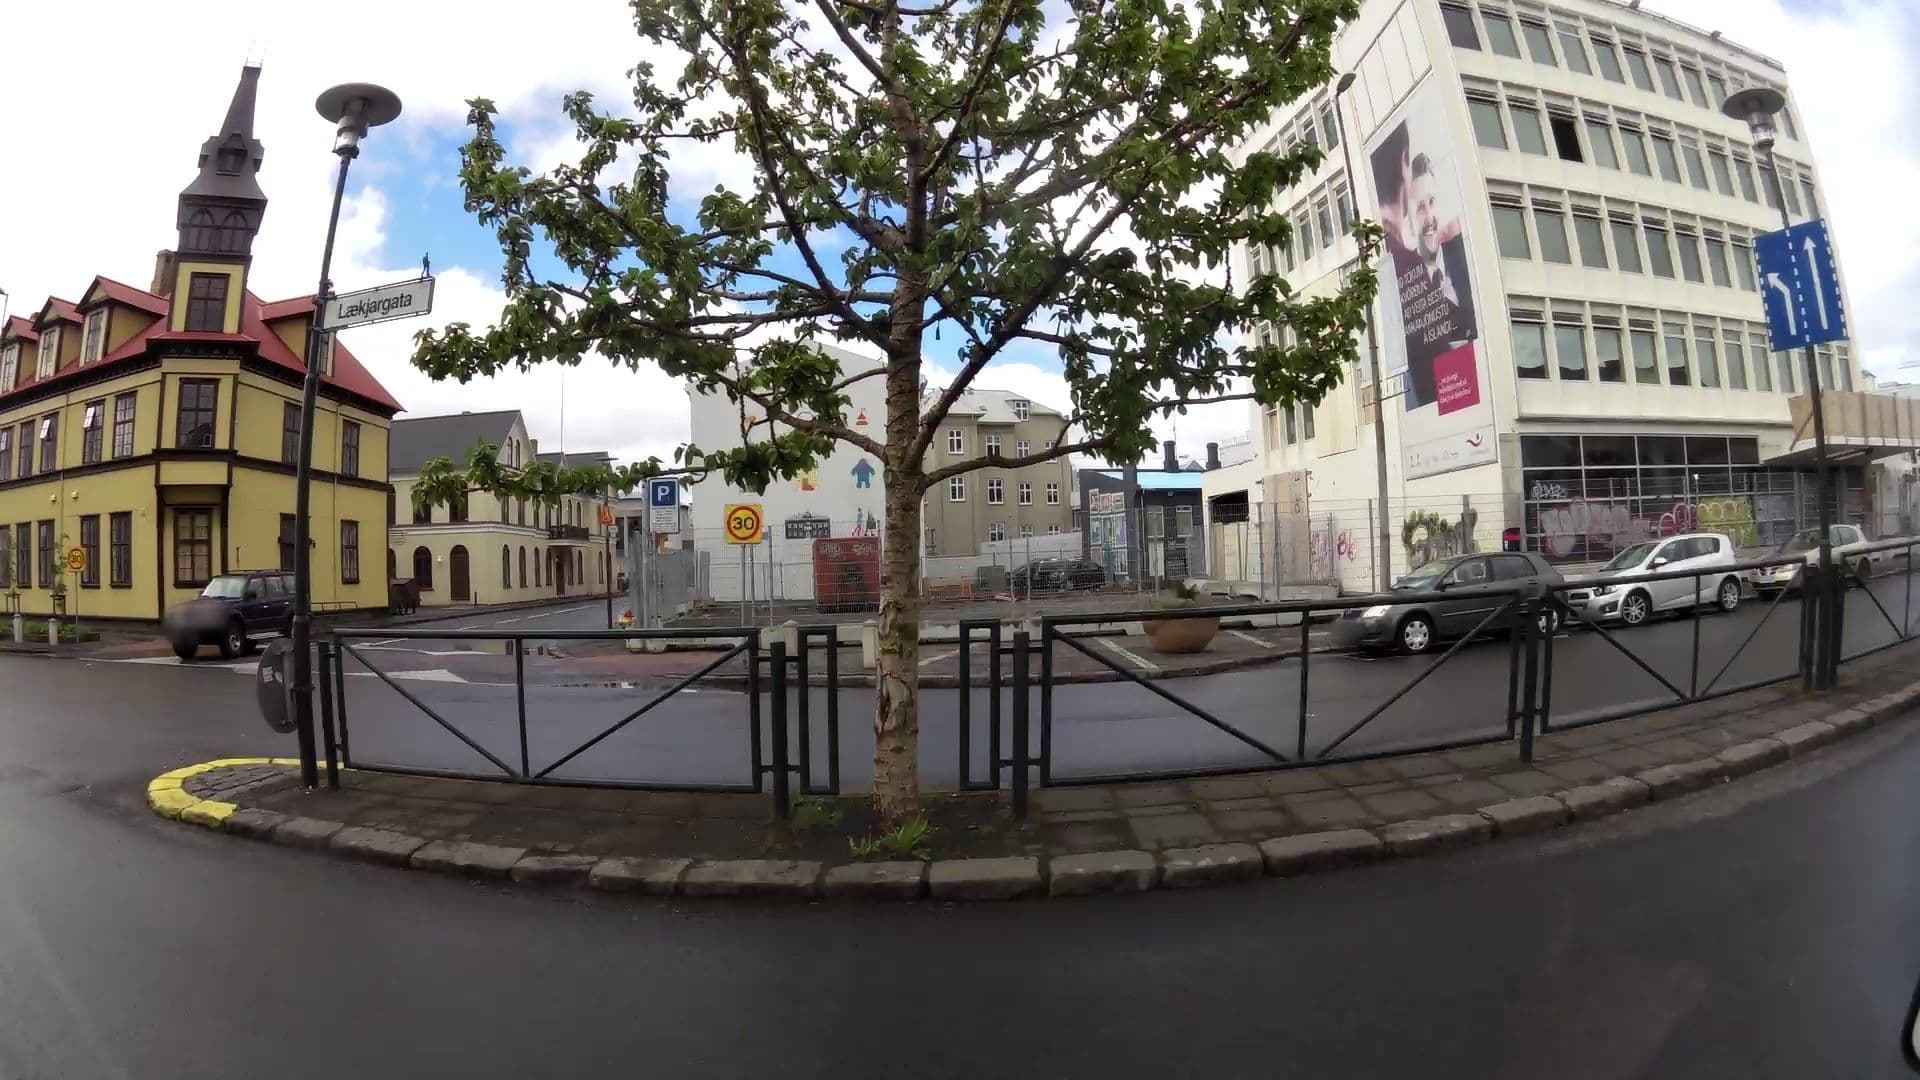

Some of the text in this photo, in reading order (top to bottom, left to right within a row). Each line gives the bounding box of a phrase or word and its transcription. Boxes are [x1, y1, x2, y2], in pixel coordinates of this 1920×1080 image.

[338, 292, 412, 319] Lækjargata
[657, 485, 670, 502] P
[732, 516, 755, 531] 30
